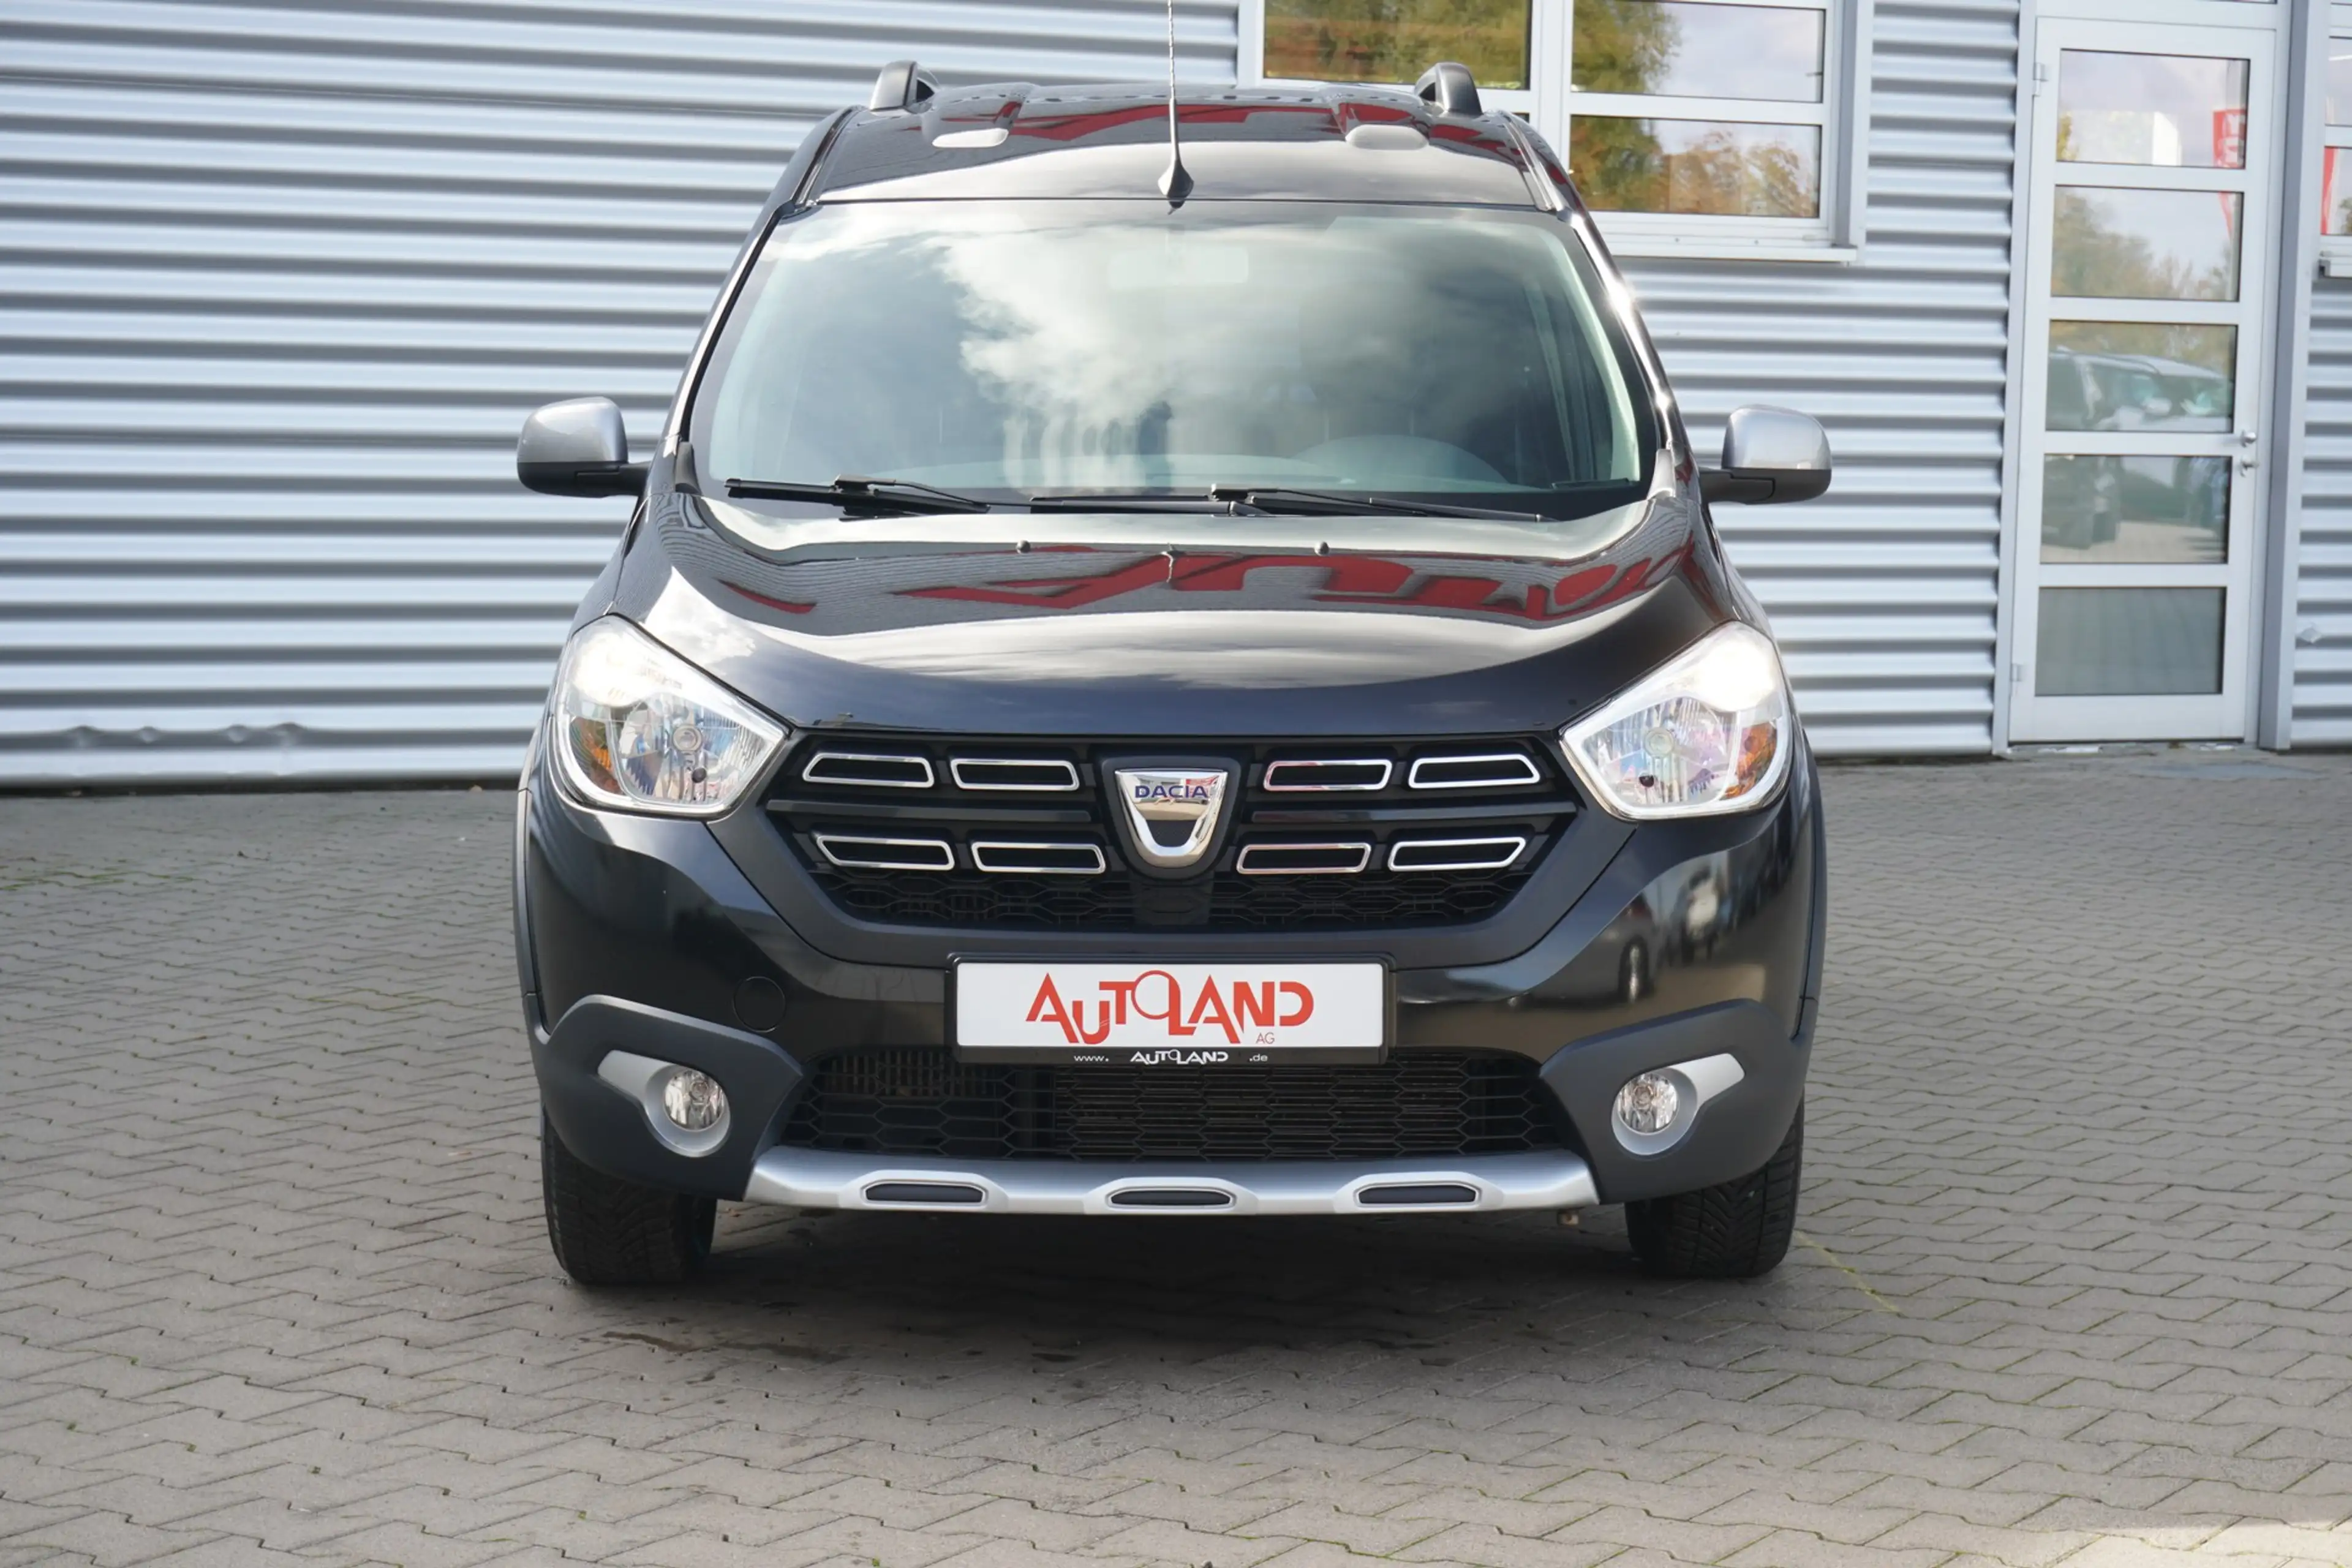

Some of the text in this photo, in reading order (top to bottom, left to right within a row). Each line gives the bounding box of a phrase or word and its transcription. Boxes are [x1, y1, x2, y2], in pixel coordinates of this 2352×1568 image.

[1135, 785, 1208, 798] DACIA
[1256, 1032, 1275, 1044] AG
[1250, 1054, 1268, 1062] .de
